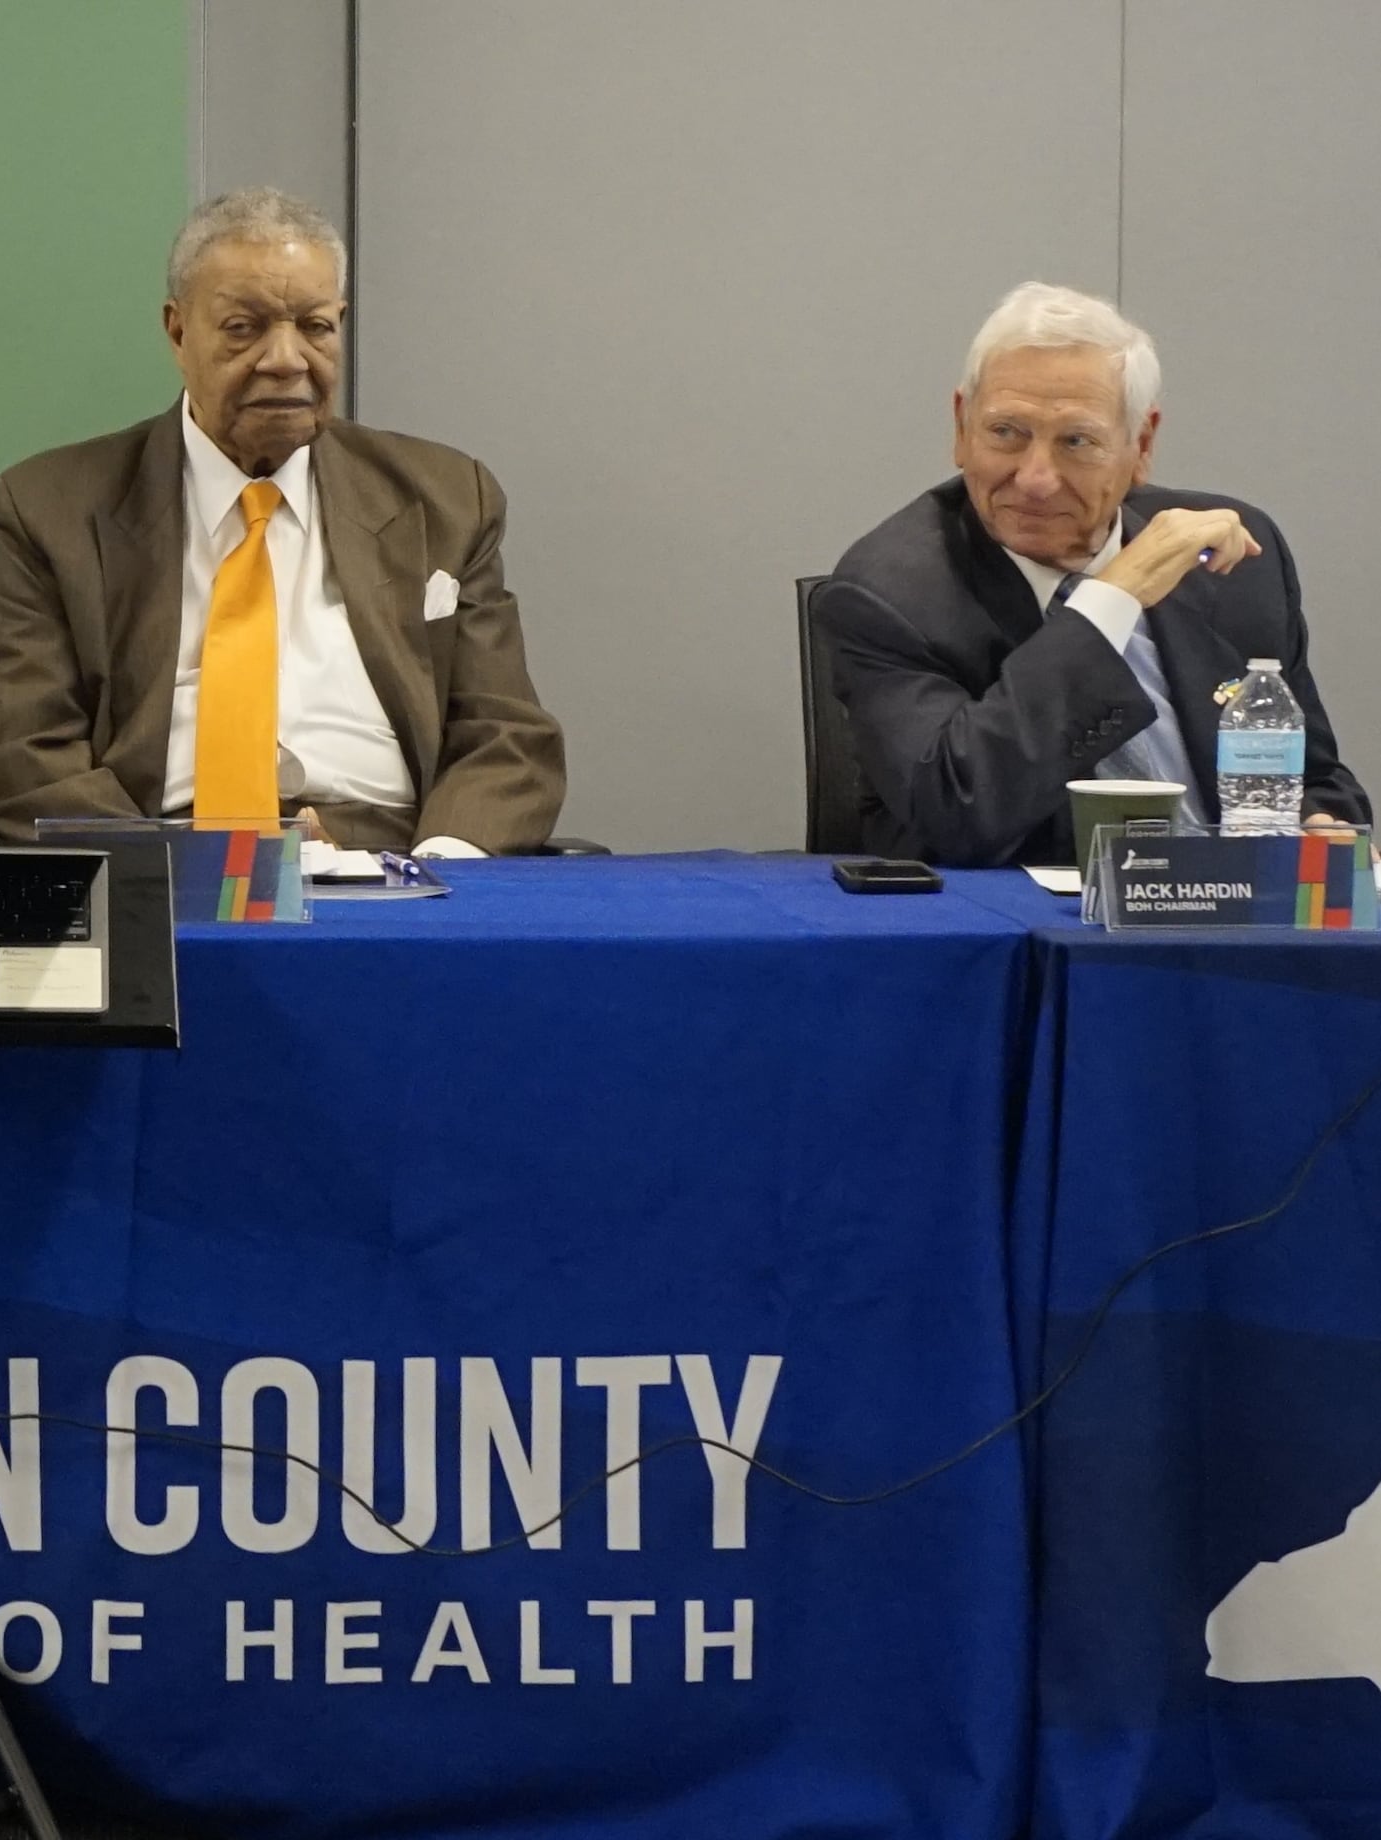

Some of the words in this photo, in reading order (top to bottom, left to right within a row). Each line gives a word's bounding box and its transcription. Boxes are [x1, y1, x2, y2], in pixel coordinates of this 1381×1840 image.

[1124, 883, 1175, 900] JACK
[1176, 883, 1253, 899] HARDIN
[1154, 901, 1218, 912] CHAIRMAN
[106, 1354, 783, 1555] COUNTY
[226, 1599, 754, 1685] HEALTH
